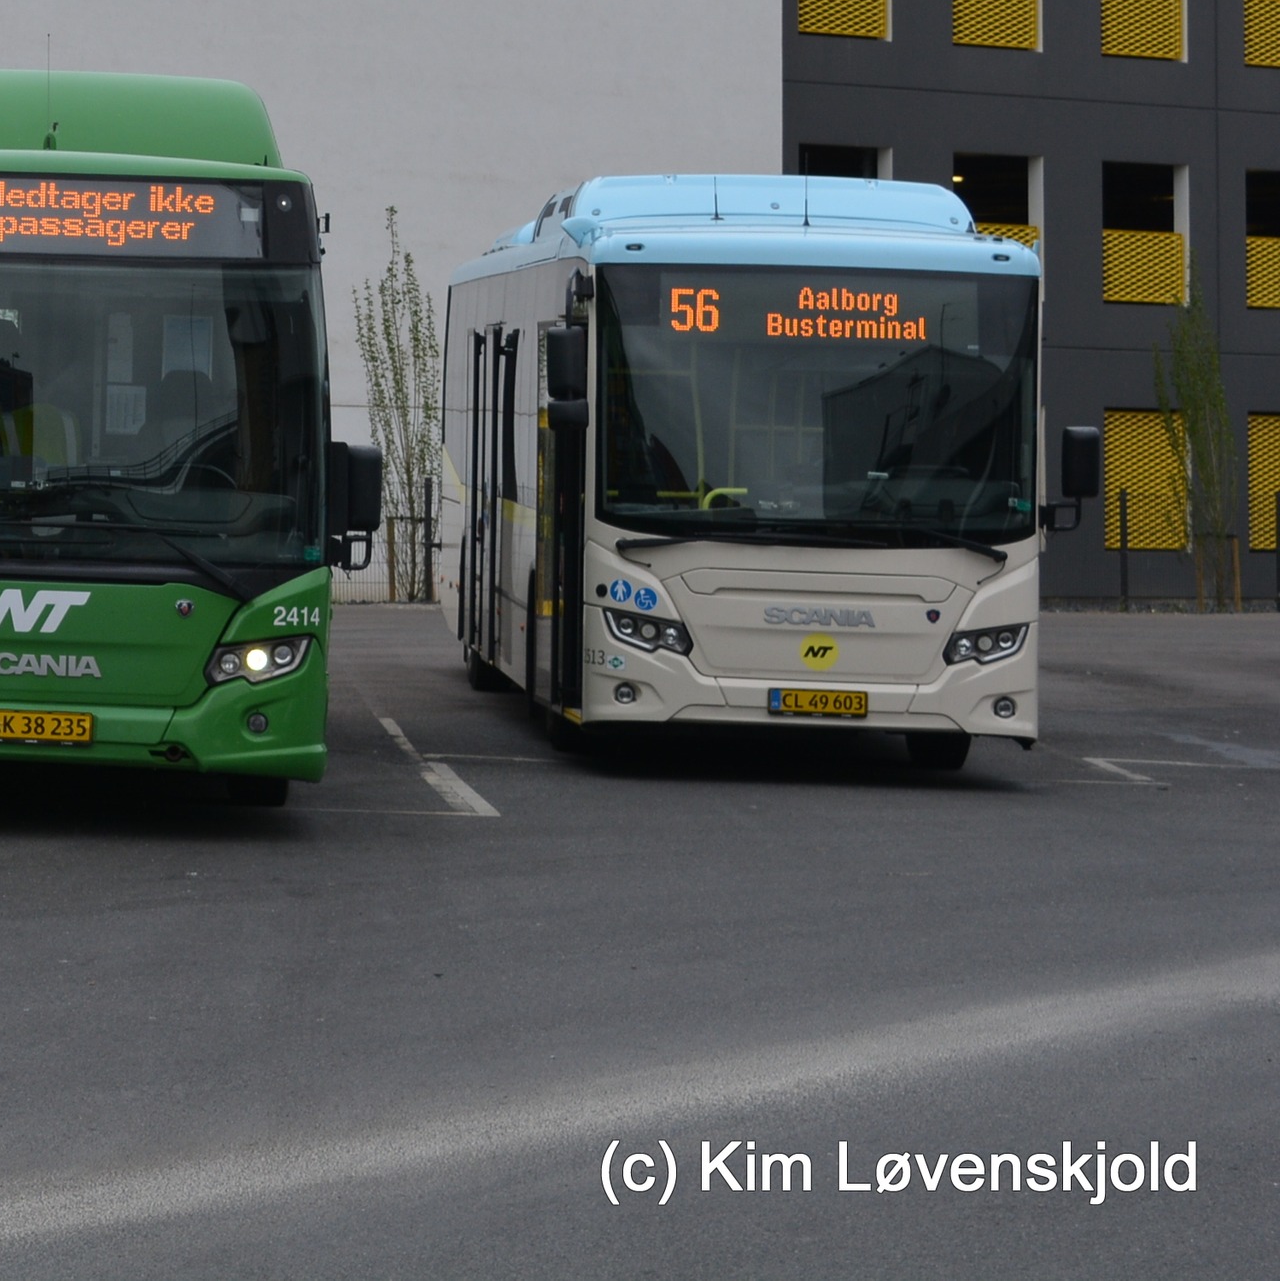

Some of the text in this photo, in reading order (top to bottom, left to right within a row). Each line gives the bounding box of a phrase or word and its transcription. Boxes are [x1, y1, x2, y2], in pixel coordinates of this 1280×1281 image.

[149, 184, 216, 215] ikke
[670, 287, 721, 333] 56
[798, 286, 899, 318] Aalborg
[766, 312, 927, 341] Busterminal
[272, 605, 320, 627] 2414
[763, 606, 876, 629] SCANIA
[803, 645, 834, 659] NT
[781, 692, 864, 711] CL 49 603
[20, 715, 46, 736] 38
[50, 717, 87, 737] 235
